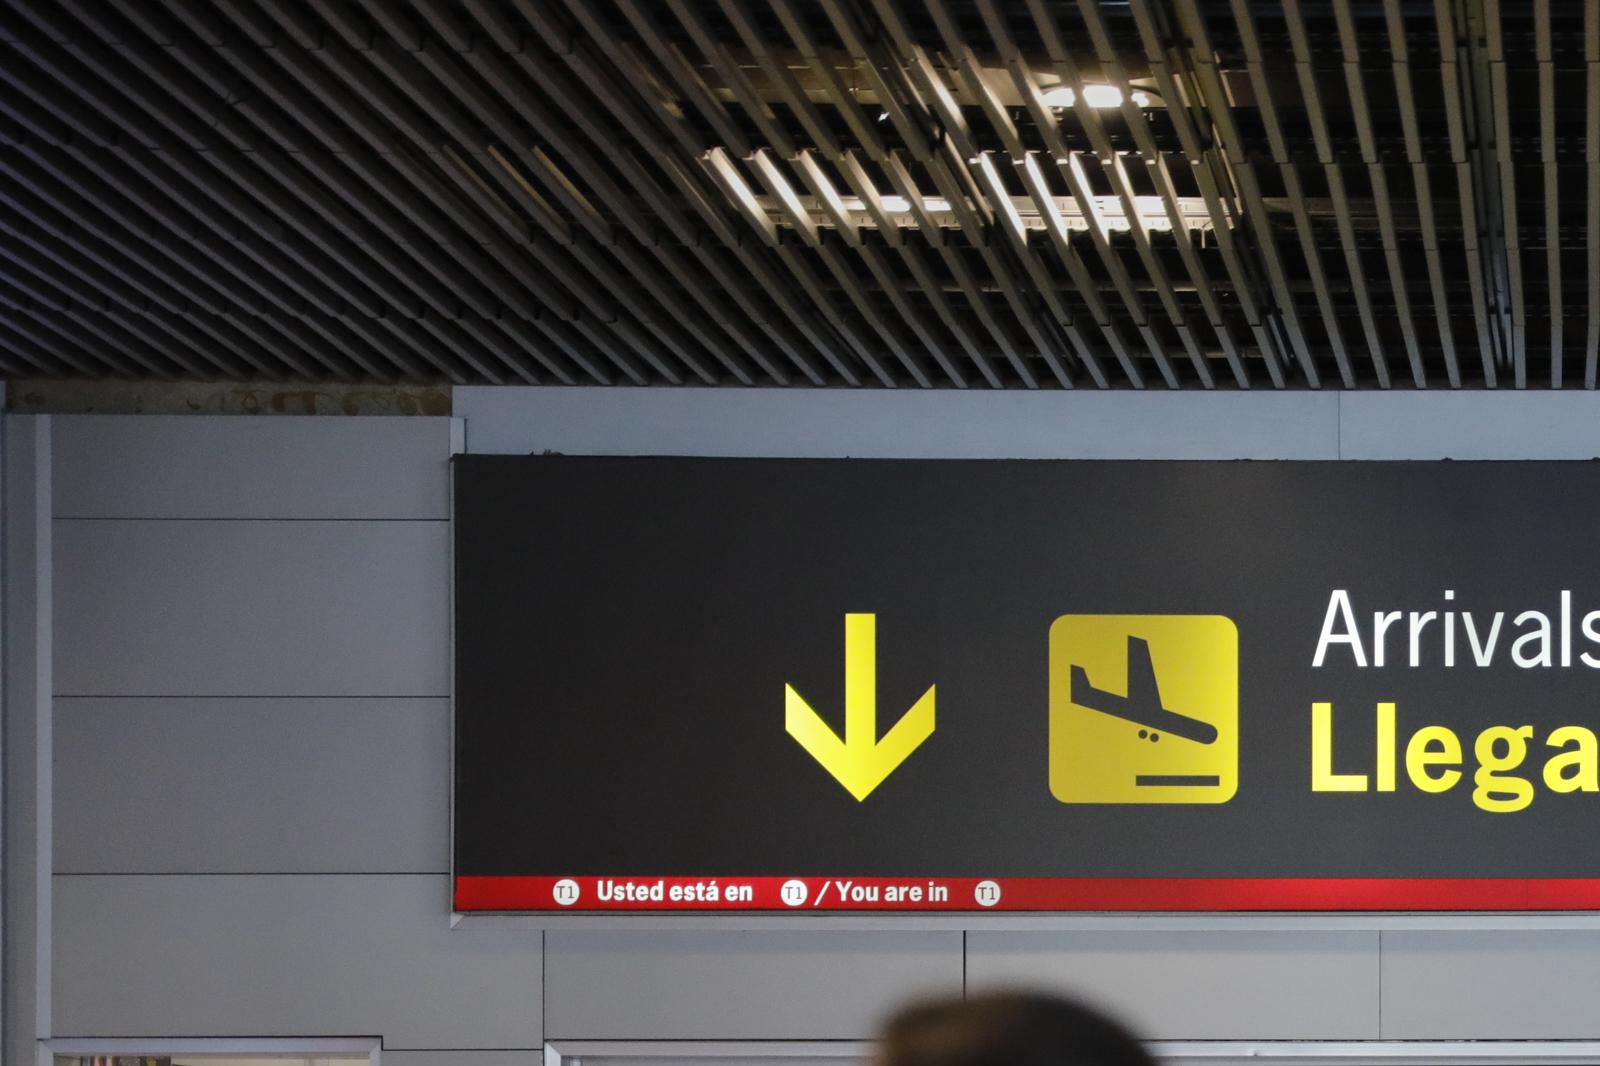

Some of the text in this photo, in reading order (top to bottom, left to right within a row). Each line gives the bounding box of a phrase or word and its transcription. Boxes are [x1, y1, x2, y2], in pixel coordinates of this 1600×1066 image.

[555, 885, 576, 900] T1
[597, 879, 665, 902] Usted
[668, 879, 720, 902] está
[724, 885, 754, 902] en
[784, 886, 803, 900] T1
[884, 886, 923, 903] are
[928, 880, 948, 903] in
[977, 886, 997, 900] T1
